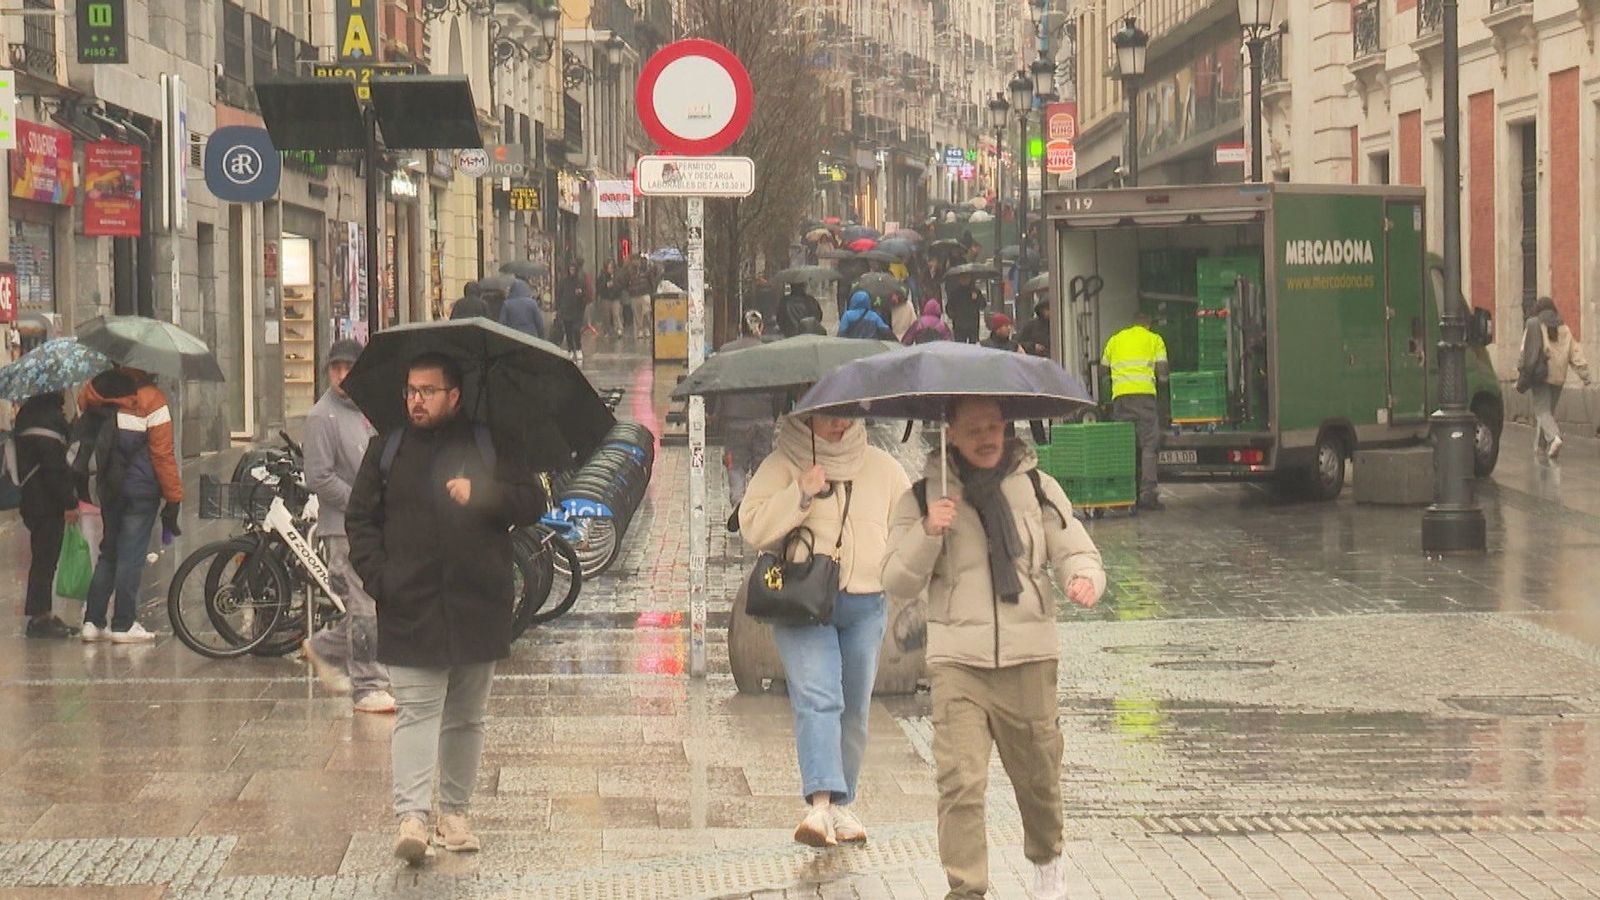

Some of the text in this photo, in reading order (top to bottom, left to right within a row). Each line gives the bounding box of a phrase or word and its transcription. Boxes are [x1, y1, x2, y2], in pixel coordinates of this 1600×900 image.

[342, 0, 372, 57] A
[84, 47, 106, 57] PISO
[1051, 127, 1073, 135] KING
[679, 162, 717, 171] PERMITIDO
[695, 171, 734, 180] DESCARGA
[647, 180, 696, 190] LABORABLES
[697, 181, 706, 189] DE
[714, 181, 720, 189] A
[1064, 197, 1093, 211] 119
[1285, 239, 1374, 265] MERCADONA
[1286, 273, 1375, 290] www.mercadona.es
